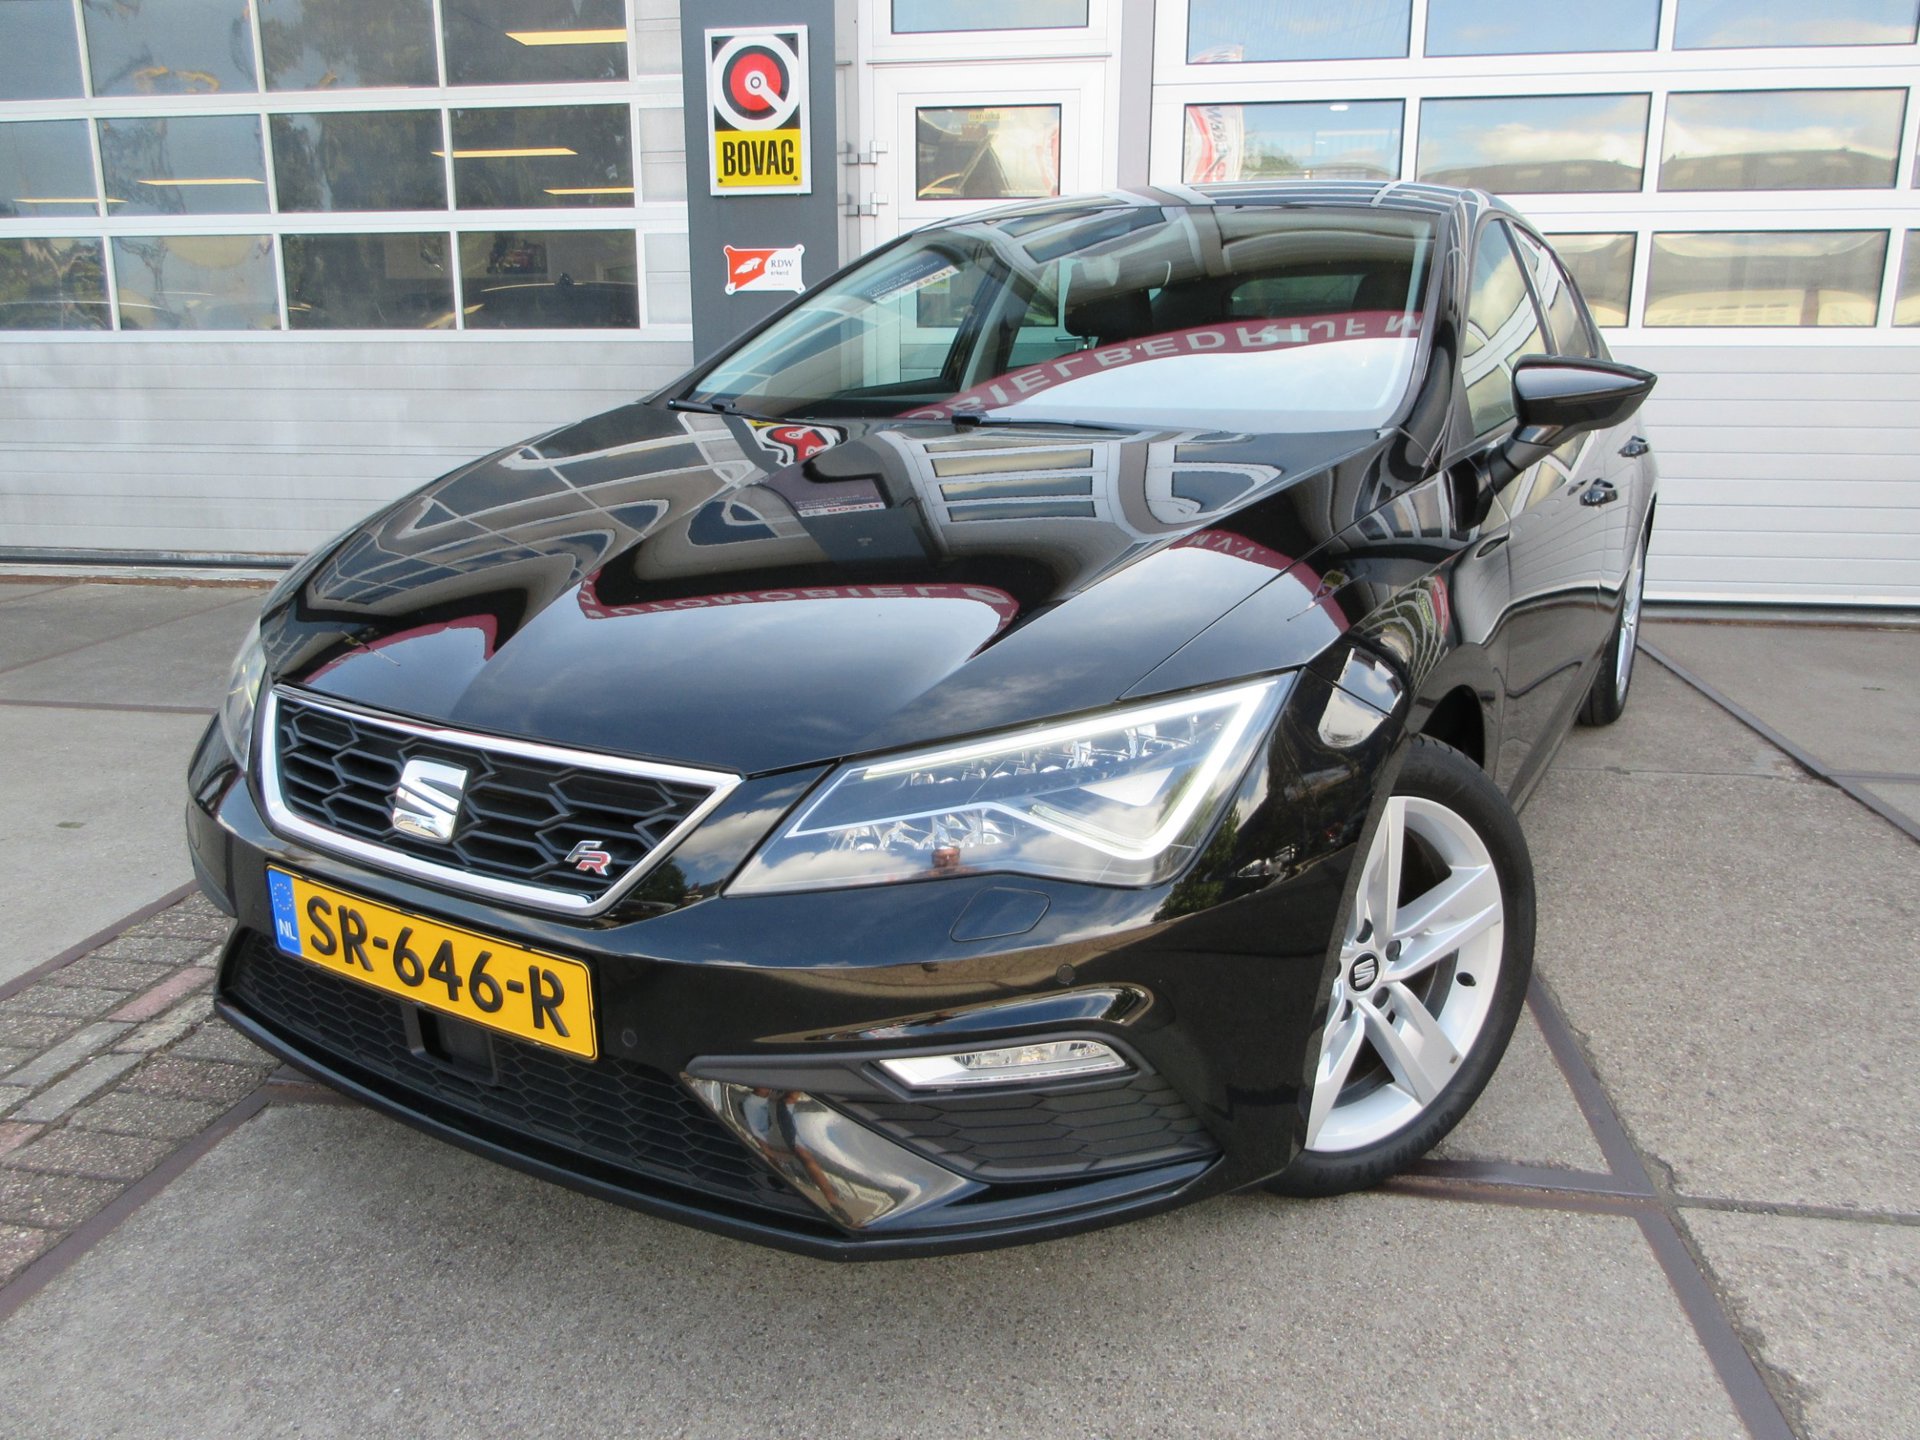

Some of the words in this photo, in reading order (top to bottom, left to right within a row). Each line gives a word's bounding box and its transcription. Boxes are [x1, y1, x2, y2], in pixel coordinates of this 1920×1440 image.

[722, 139, 795, 177] BOVAG
[770, 258, 794, 269] RDW
[565, 840, 612, 876] FR
[279, 918, 298, 942] NL
[306, 895, 571, 1039] SR-646-R
